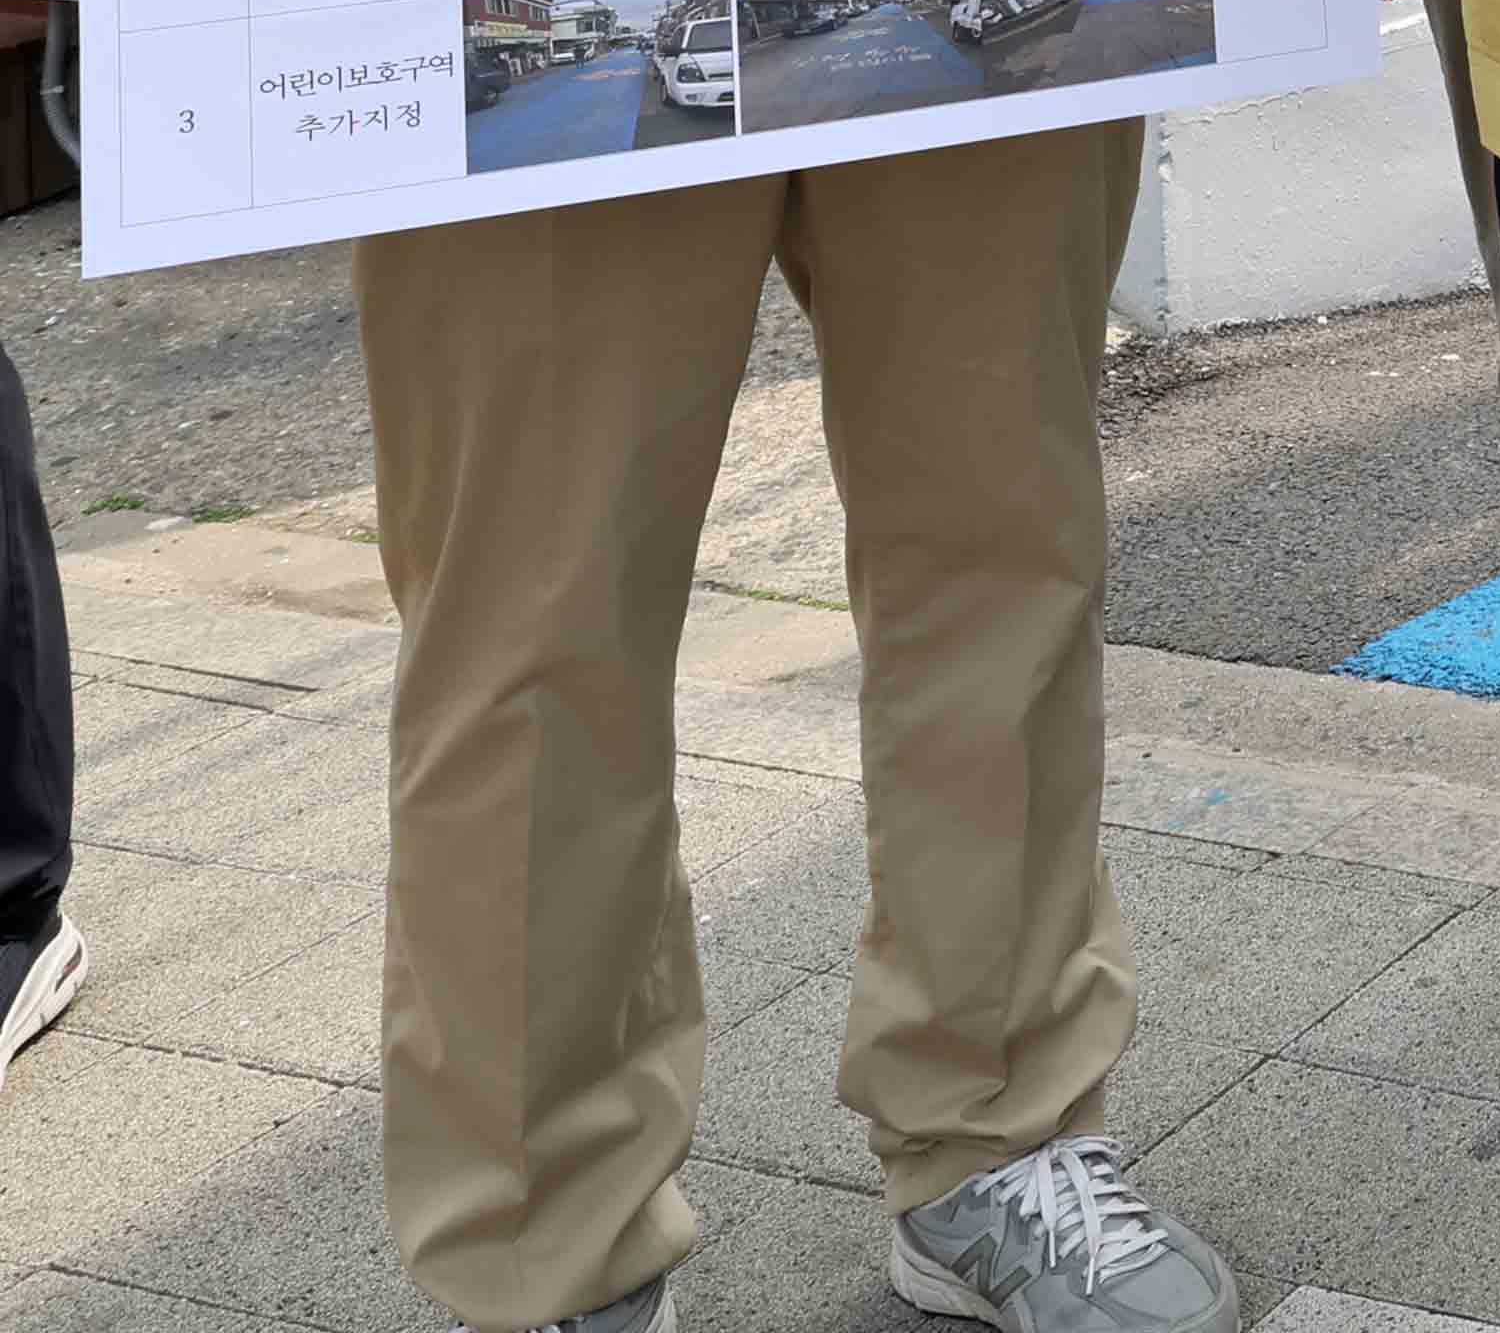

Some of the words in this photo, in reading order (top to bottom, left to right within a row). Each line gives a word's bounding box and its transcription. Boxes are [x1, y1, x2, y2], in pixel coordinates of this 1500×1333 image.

[259, 51, 455, 101] 어린이보호구역
[178, 108, 196, 135] 3
[294, 100, 423, 143] 추가지정
